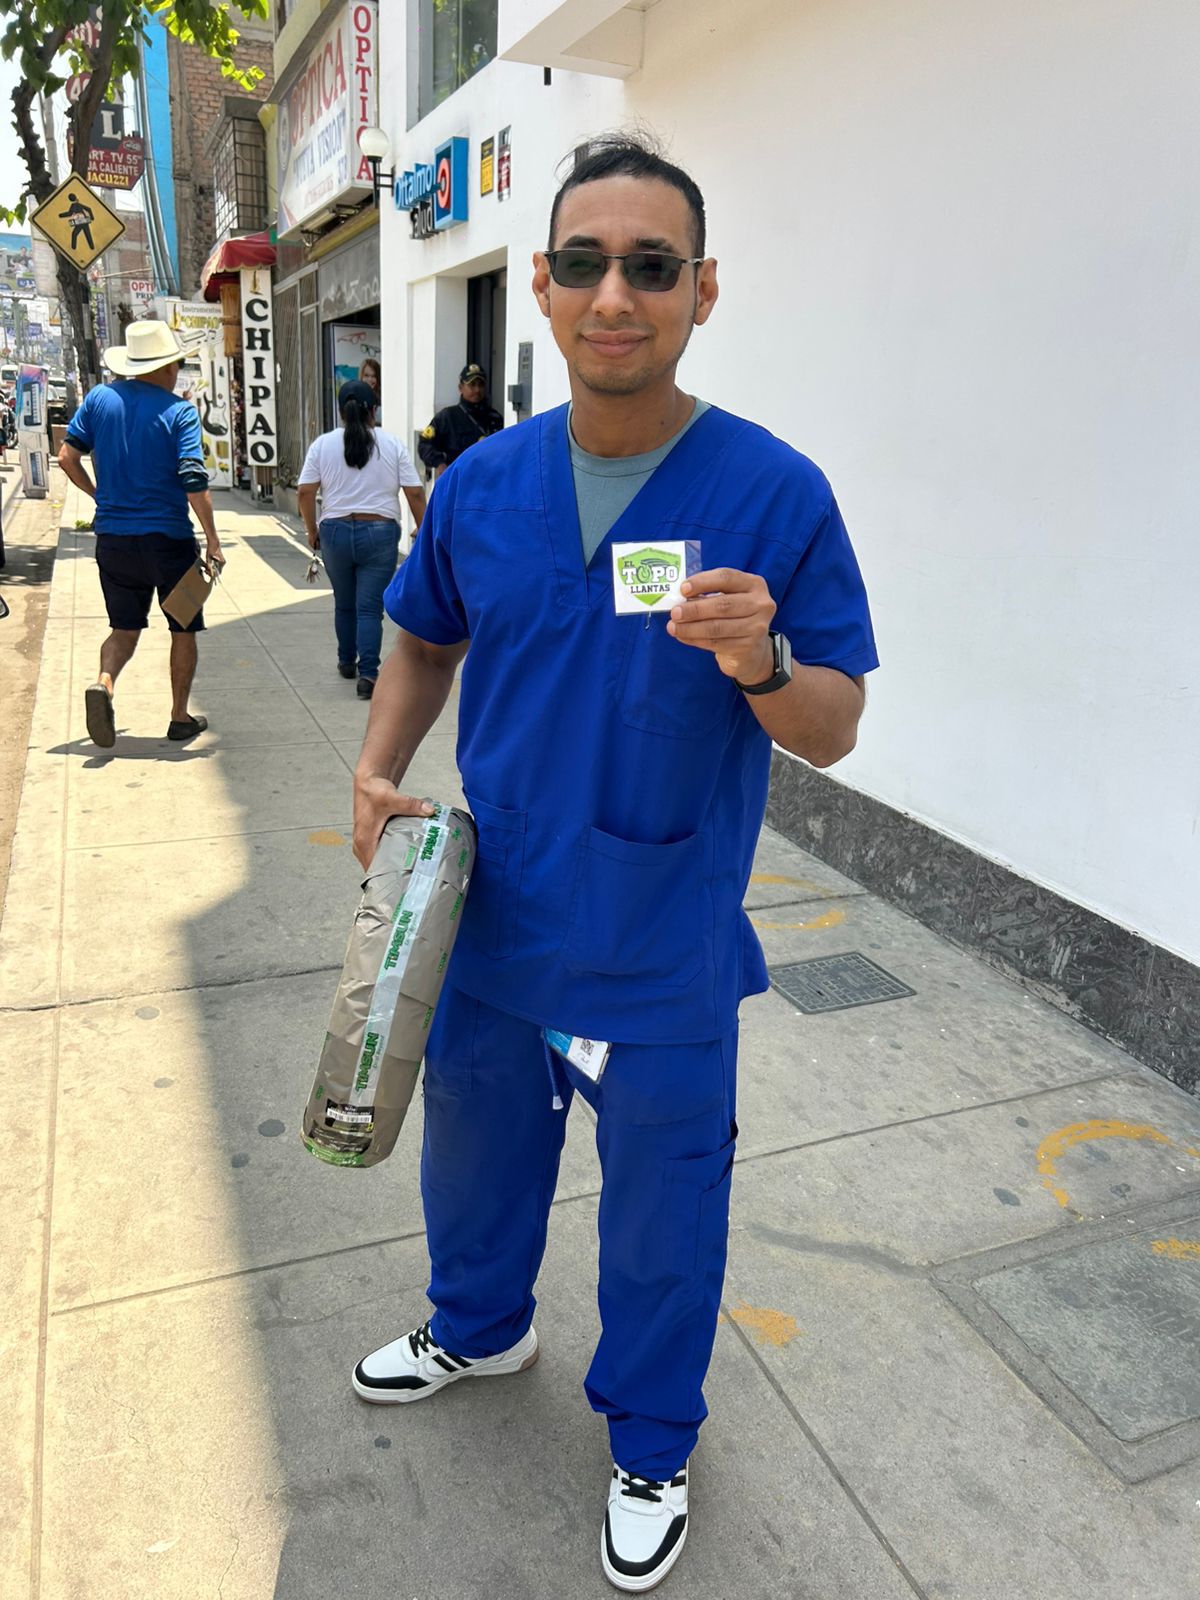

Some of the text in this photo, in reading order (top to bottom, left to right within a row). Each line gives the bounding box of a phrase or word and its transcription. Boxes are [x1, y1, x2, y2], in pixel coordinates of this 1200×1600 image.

[290, 27, 347, 147] OPTICA
[99, 162, 139, 176] CALIENTE
[110, 151, 124, 164] TV
[87, 172, 129, 186] JACUZZI
[245, 298, 275, 463] CHIPAO
[630, 584, 671, 594] LLANTAS
[384, 909, 414, 971] TIMSUN
[355, 1031, 380, 1092] TIMSUN
